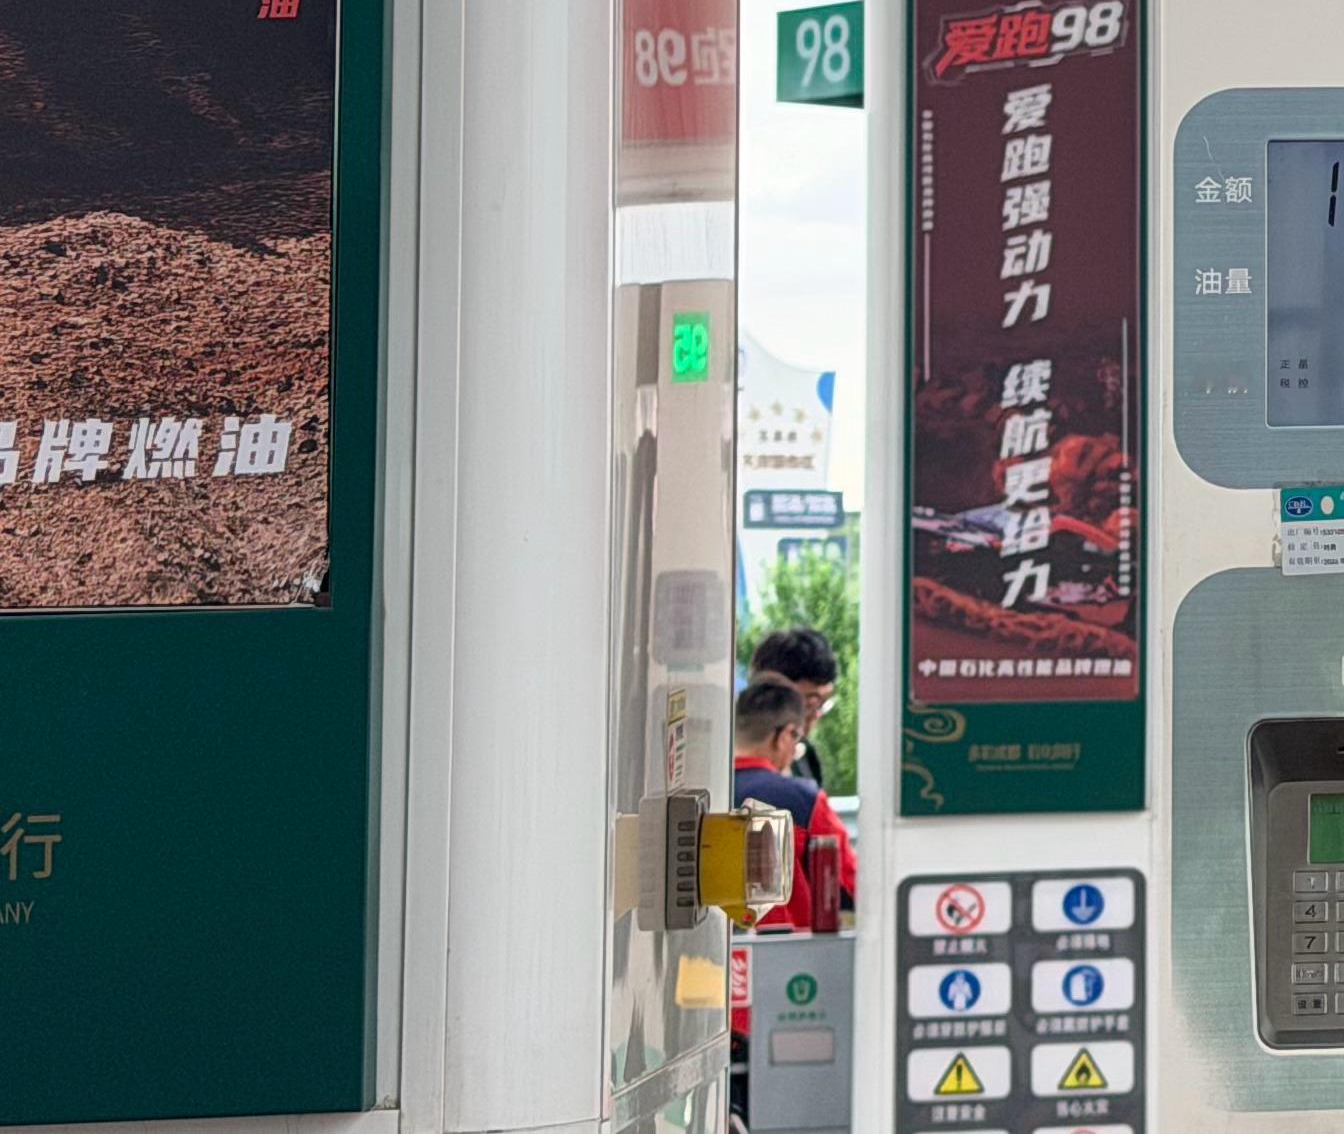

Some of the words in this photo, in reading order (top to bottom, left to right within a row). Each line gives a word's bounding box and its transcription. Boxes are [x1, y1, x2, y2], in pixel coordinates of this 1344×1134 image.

[796, 14, 850, 87] 98
[935, 0, 1124, 79] 爱跑98
[1001, 83, 1053, 328] 爱跑强动力
[1194, 176, 1253, 204] 金额
[1194, 267, 1253, 295] 油量
[0, 415, 293, 485] 牌燃油
[1001, 359, 1053, 609] 续航更给力
[1304, 904, 1316, 918] 4
[1304, 935, 1316, 949] 7
